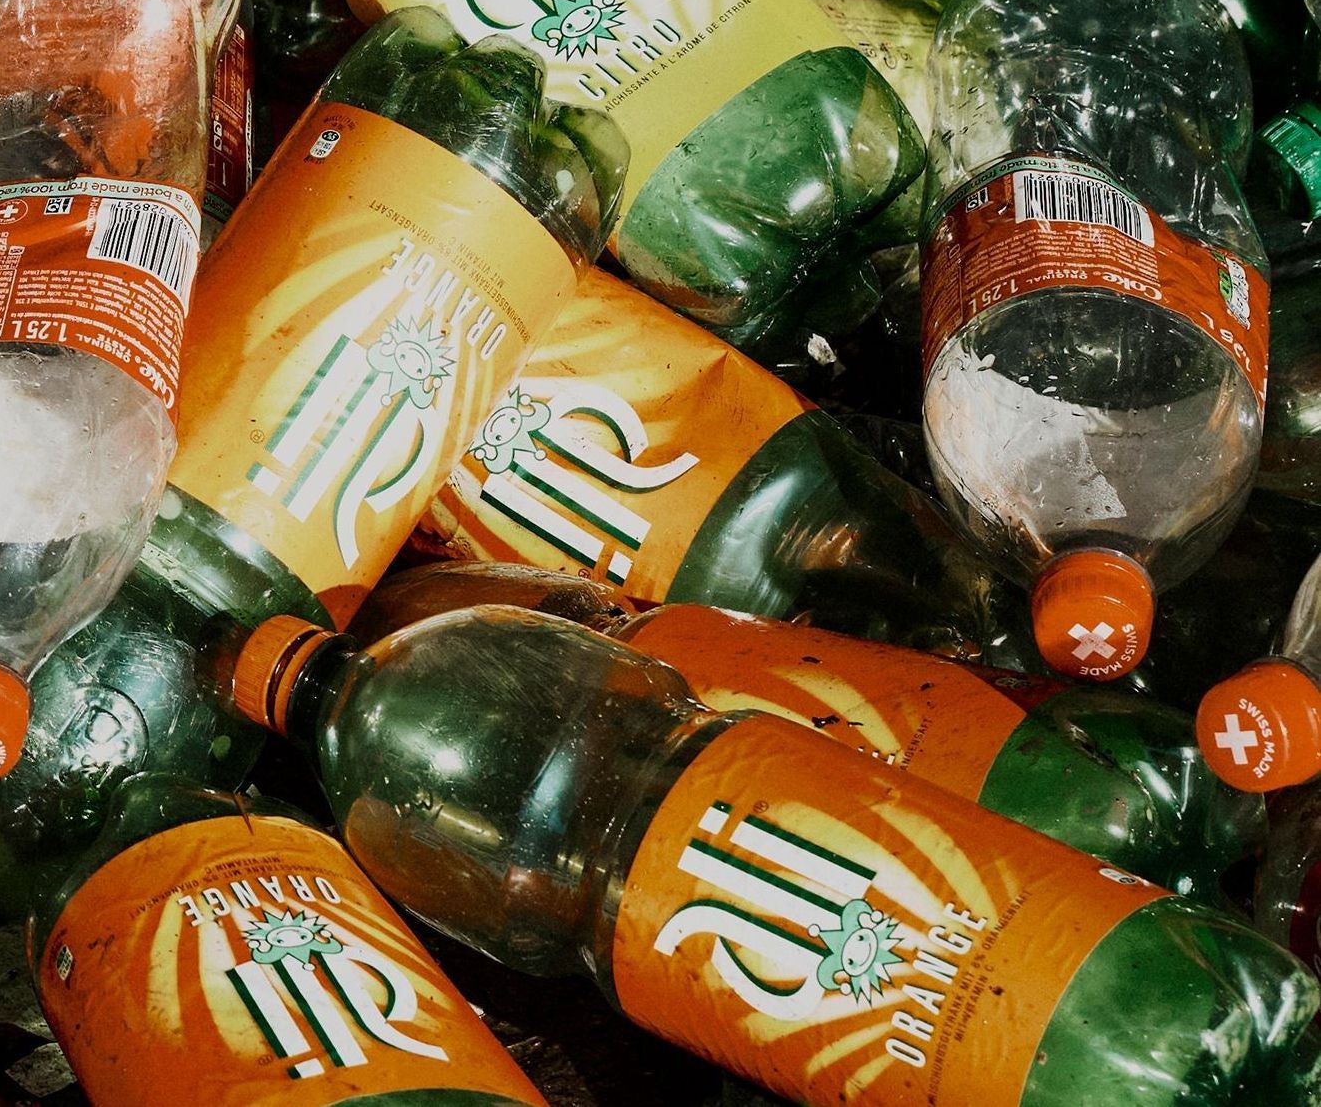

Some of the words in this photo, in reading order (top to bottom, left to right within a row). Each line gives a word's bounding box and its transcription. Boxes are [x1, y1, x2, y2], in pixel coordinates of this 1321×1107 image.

[705, 20, 720, 35] DE
[576, 18, 683, 101] CITRO
[1000, 159, 1036, 170] made
[19, 182, 54, 197] 100%
[56, 178, 88, 194] from
[90, 178, 129, 194] made
[132, 183, 172, 200] bottle
[174, 193, 182, 201] a
[114, 196, 166, 218] 028921
[367, 198, 436, 245] ORANGENSAFT
[982, 277, 1017, 303] 1.25
[1024, 272, 1087, 283] ORIGINAL
[1102, 272, 1161, 300] Coke
[382, 236, 508, 362] ORANGE
[967, 298, 975, 312] L
[9, 318, 23, 338] L
[25, 316, 69, 344] 1.25
[74, 332, 130, 362] ORIGINAL
[96, 333, 131, 354] TASTE
[138, 364, 177, 411] Coke
[1121, 624, 1135, 663] SWISS
[1079, 661, 1122, 676] MADE
[1238, 697, 1274, 750] SWISS
[1253, 742, 1275, 779] MADE
[176, 873, 342, 928] ORANGE
[958, 968, 977, 989] MIT
[980, 887, 1032, 951] ORANGENSAFT
[885, 901, 988, 1068] ORANGE
